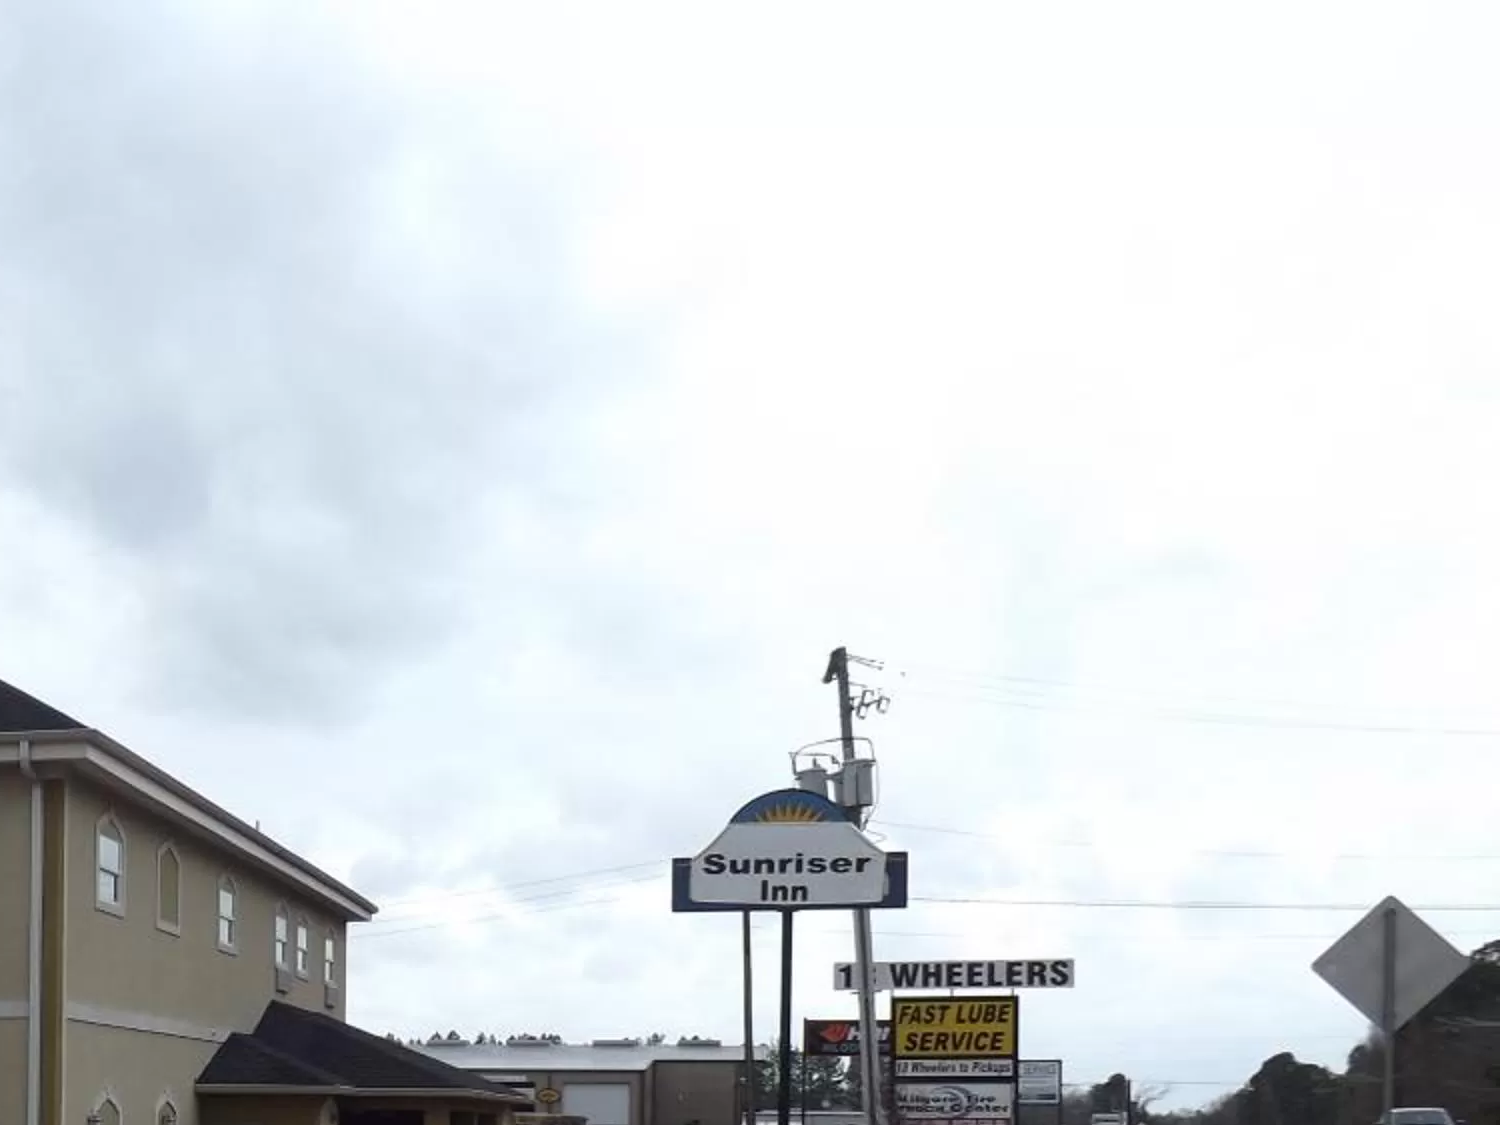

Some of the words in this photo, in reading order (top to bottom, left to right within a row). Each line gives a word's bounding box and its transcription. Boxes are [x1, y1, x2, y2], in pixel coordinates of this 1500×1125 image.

[703, 853, 871, 875] Sunriser
[760, 880, 809, 902] Inn
[889, 960, 1070, 988] WHEELERS
[898, 1005, 951, 1024] FAST
[956, 1003, 1010, 1023] LUBE
[904, 1031, 1004, 1051] SERVICE
